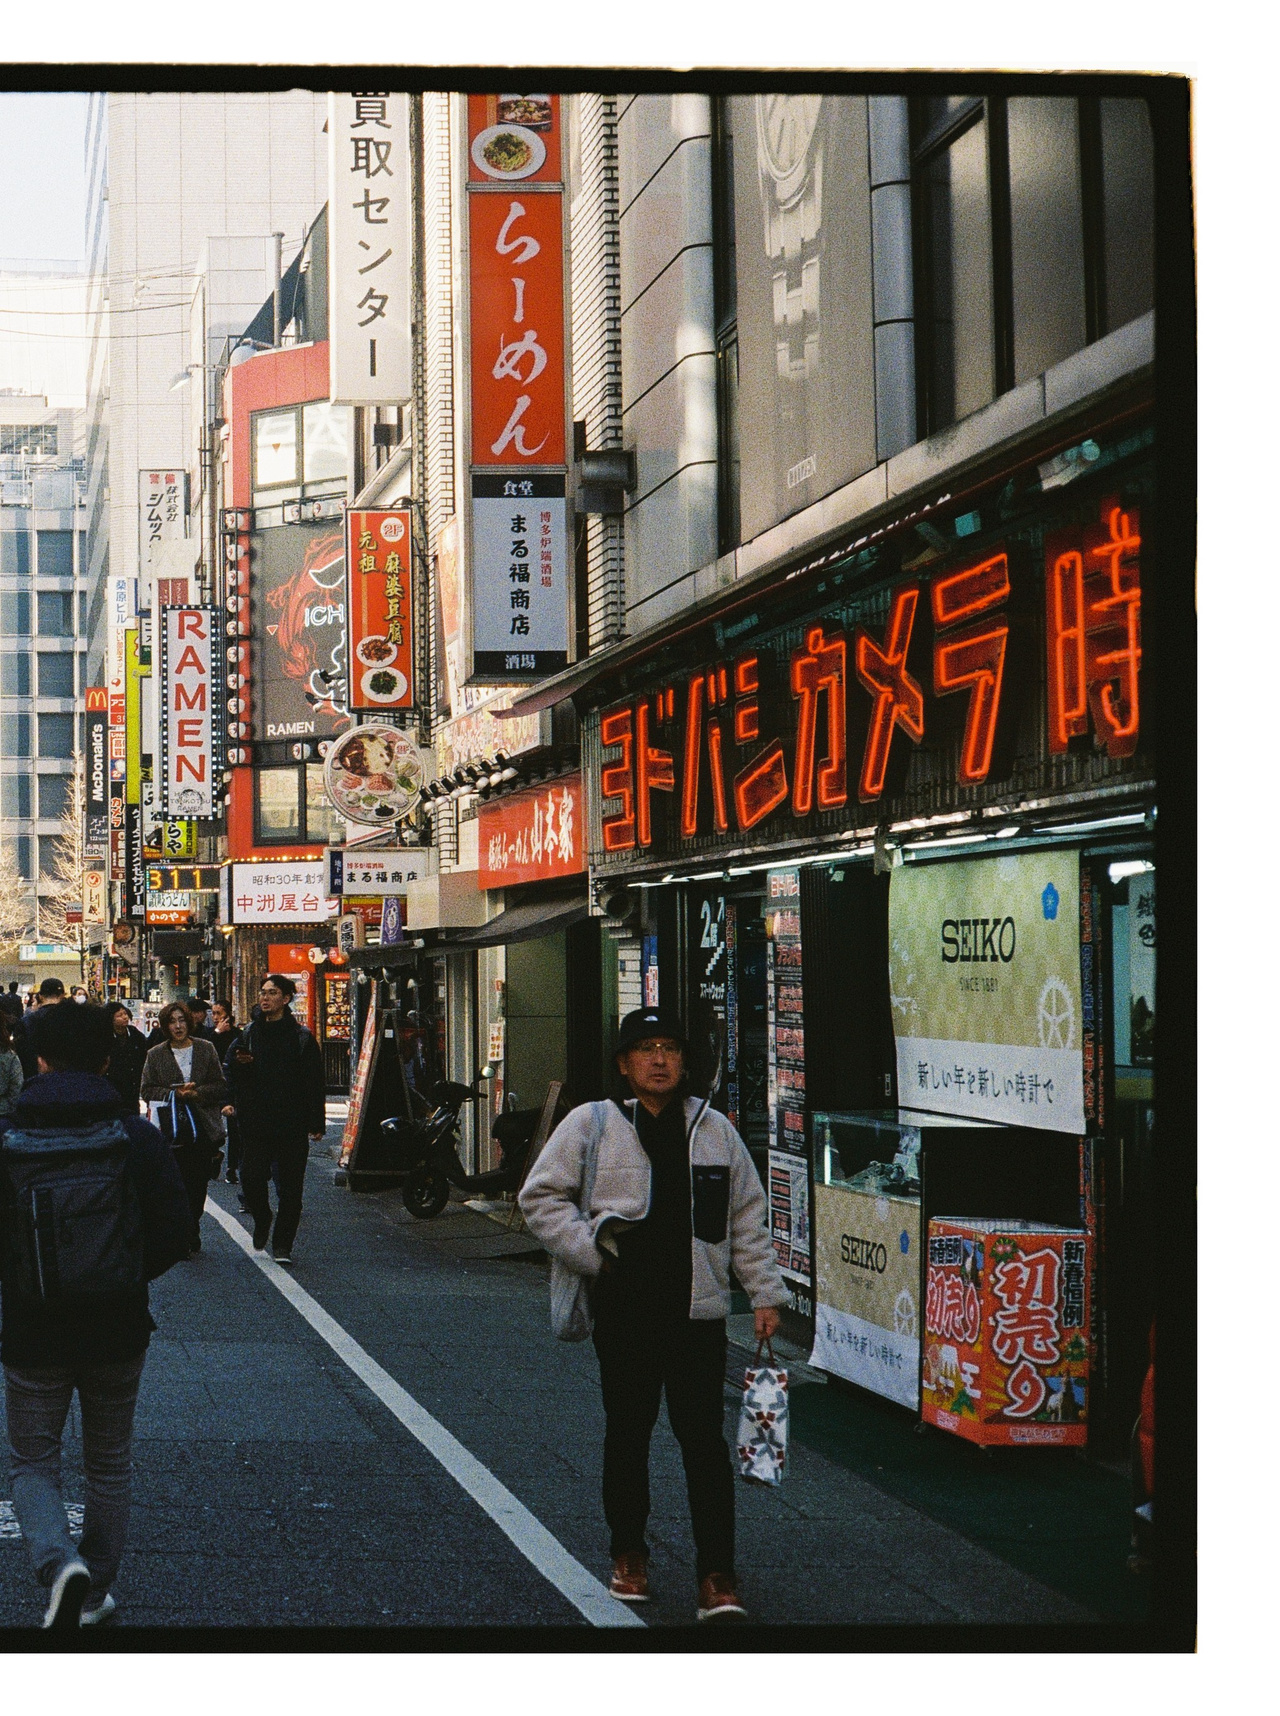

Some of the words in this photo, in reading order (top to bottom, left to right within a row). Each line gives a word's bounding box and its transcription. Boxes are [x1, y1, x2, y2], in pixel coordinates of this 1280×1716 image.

[491, 201, 551, 456] らーめん
[166, 486, 180, 522] 株式会社
[503, 480, 534, 496] 食堂
[358, 531, 378, 574] 元祖
[383, 524, 403, 537] 2F
[539, 511, 552, 588] 博多炉端酒場
[509, 514, 530, 636] まる福商店
[116, 579, 127, 624] 桑原ビル
[382, 552, 406, 645] 麻婆豆腐
[505, 654, 536, 670] 酒場
[175, 610, 208, 783] RAMEN
[600, 551, 1011, 854] ヨドバシカメラ
[267, 721, 316, 737] RAMEN
[92, 723, 104, 802] McDonald's
[166, 820, 183, 855] らや
[346, 870, 418, 884] まる福商店
[150, 911, 180, 922] かのや
[941, 915, 1017, 965] SEIKO
[960, 976, 981, 992] SINCE
[917, 1060, 1056, 1106] 新しい年を新しい時計で
[840, 1233, 889, 1275] SEIKO
[1062, 1239, 1086, 1329] 新春恒例
[991, 1248, 1062, 1419] 初売り
